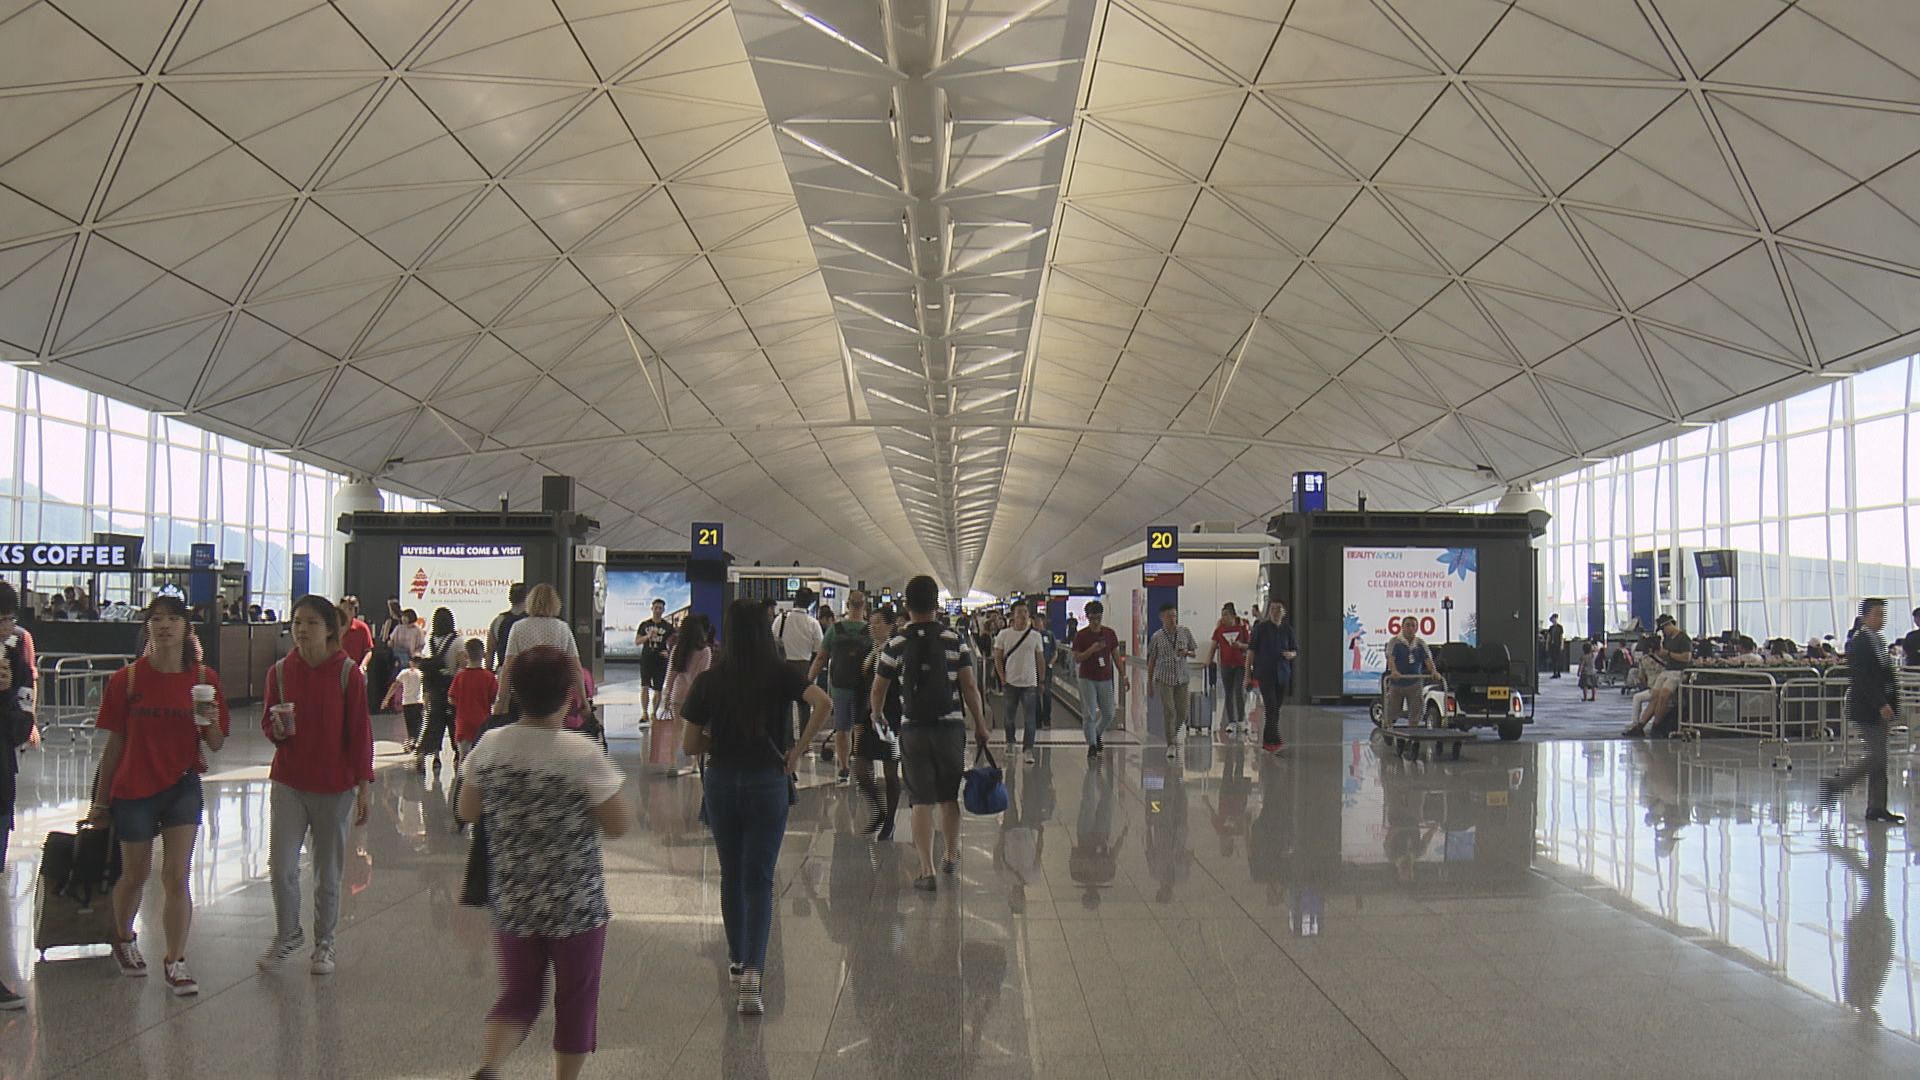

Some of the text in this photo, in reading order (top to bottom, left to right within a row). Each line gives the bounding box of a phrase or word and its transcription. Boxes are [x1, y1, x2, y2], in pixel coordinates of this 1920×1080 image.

[698, 528, 718, 545] 21
[1151, 532, 1173, 549] 20
[32, 545, 125, 566] COFFEE
[402, 546, 522, 555] BUYERS: PLEASE COME & VISIT
[1053, 574, 1065, 584] 22
[1374, 570, 1446, 580] GRAND OPENING
[1367, 579, 1453, 588] CELEBRATION OFFER
[1387, 616, 1436, 636] 60
